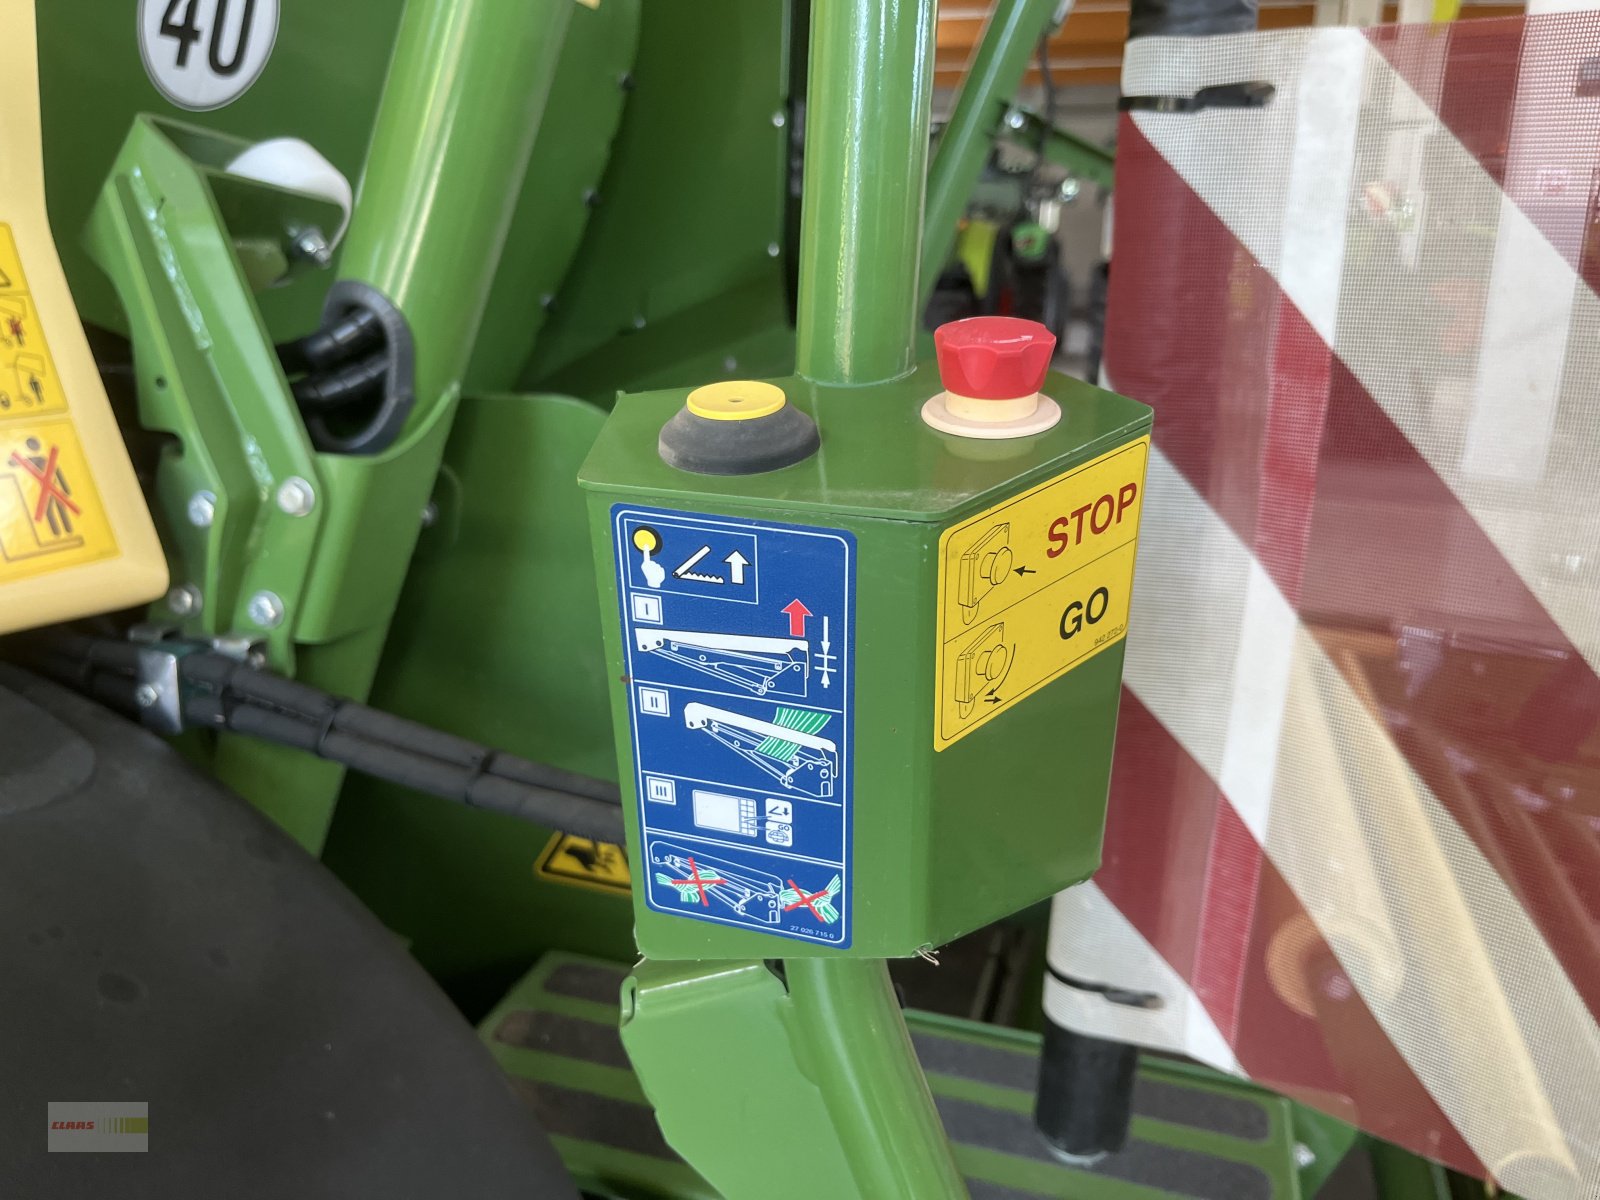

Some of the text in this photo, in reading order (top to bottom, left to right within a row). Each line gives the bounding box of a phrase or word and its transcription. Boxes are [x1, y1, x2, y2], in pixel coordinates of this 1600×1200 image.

[160, 0, 256, 76] 40
[1046, 482, 1138, 559] STOP
[1059, 586, 1109, 640] GO
[815, 930, 828, 938] 715
